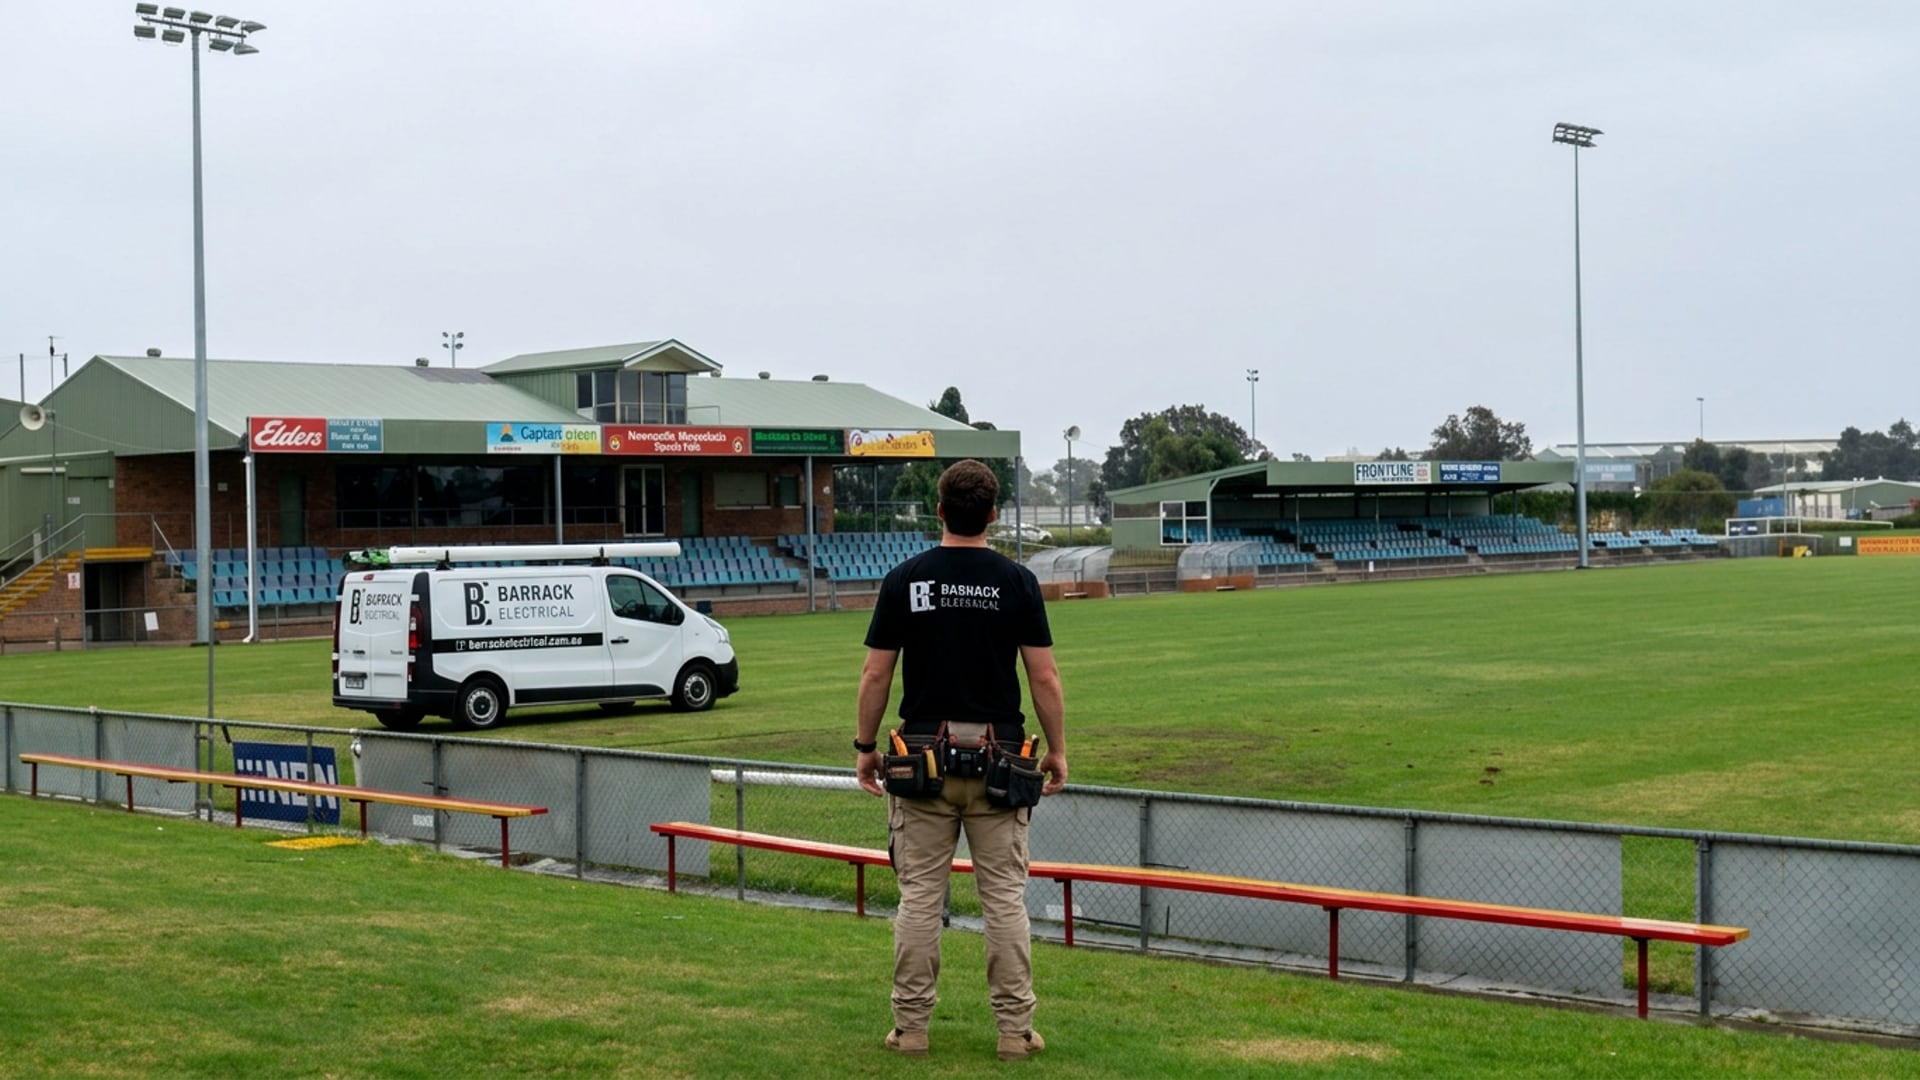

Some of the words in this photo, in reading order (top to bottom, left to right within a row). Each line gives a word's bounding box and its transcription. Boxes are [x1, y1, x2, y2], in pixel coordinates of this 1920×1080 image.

[254, 420, 322, 446] Elders
[498, 584, 574, 602] BARRACK
[499, 606, 574, 620] ELECTRICAL
